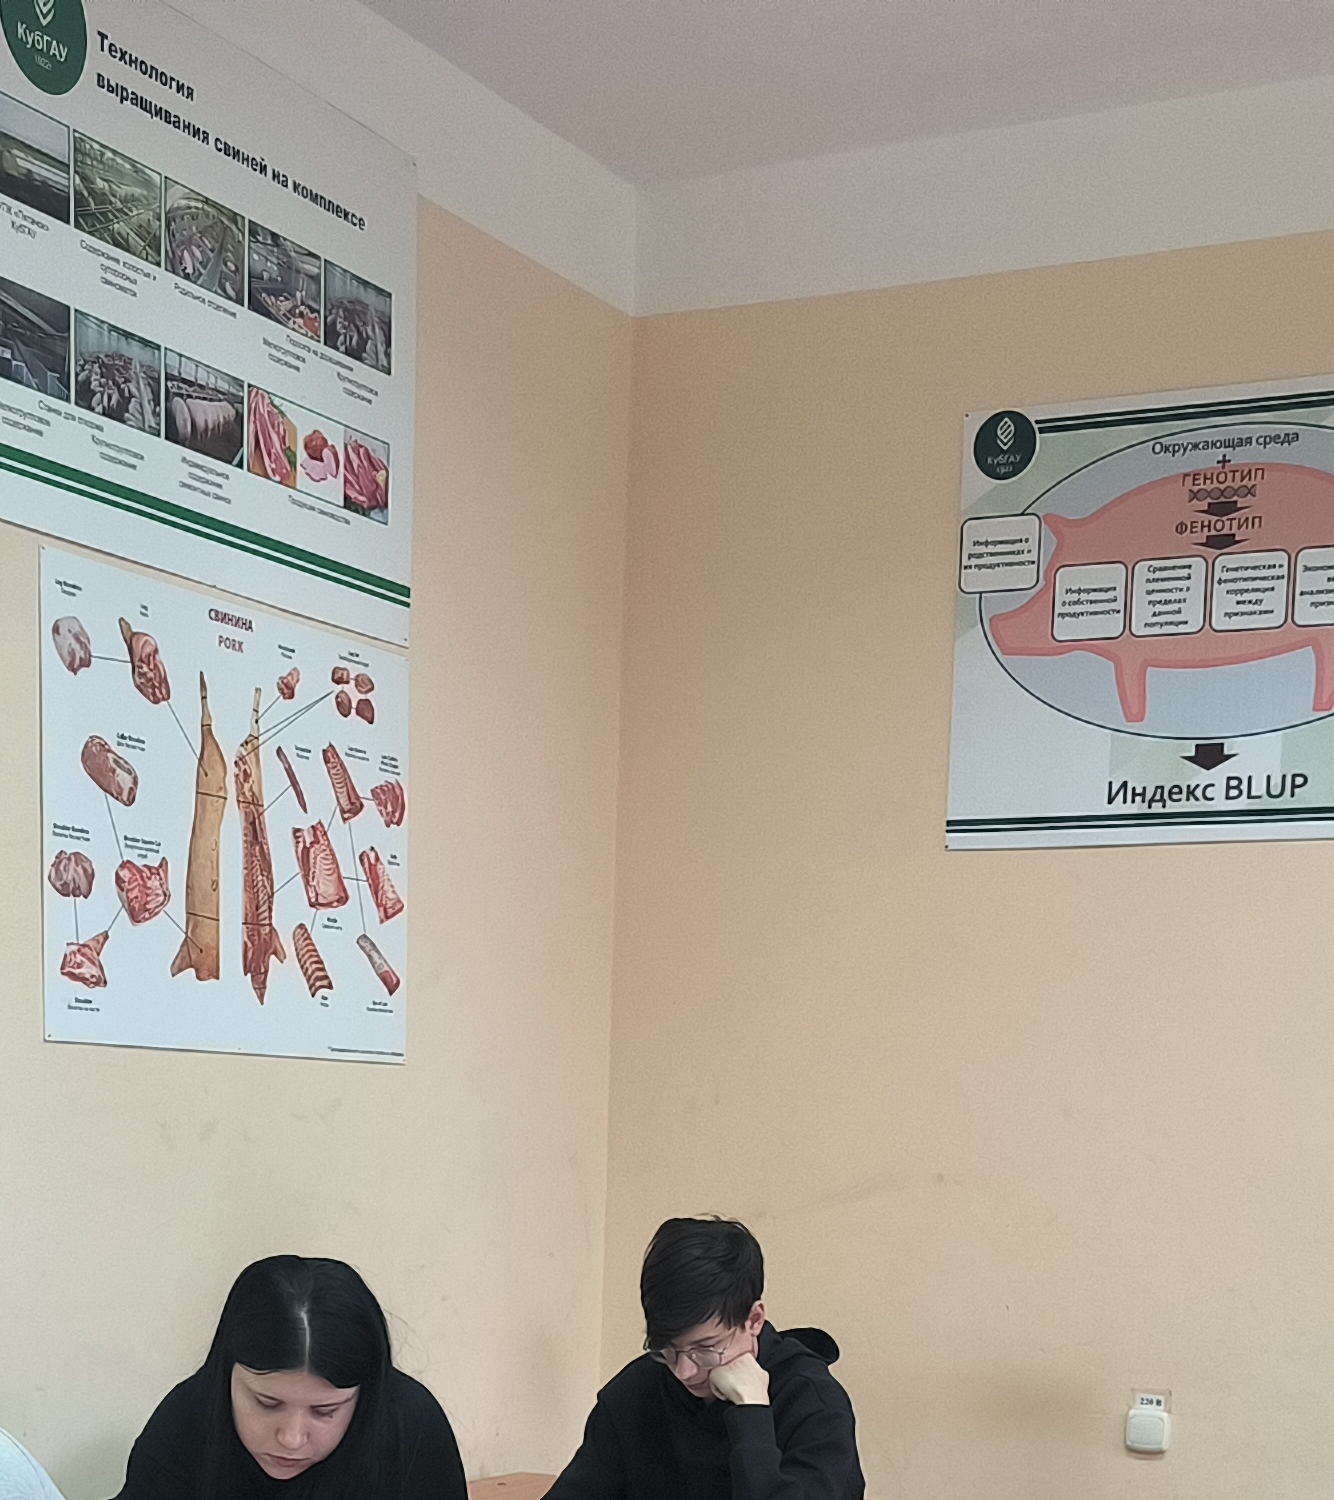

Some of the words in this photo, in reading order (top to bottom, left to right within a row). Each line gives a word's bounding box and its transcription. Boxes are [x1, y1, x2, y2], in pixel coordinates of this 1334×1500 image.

[17, 20, 68, 62] КубГАУ
[97, 30, 195, 102] Технология
[97, 72, 210, 146] выращивания
[214, 137, 268, 178] свиней
[271, 168, 289, 188] на
[292, 179, 366, 232] комплексе
[1151, 435, 1252, 457] Окружающая
[1256, 431, 1300, 449] среда
[1181, 467, 1265, 487] ГЕНОТИП
[1175, 515, 1263, 536] ФЕНОТИП
[208, 608, 254, 633] СВИНИНА
[218, 635, 245, 654] PORK
[1107, 780, 1216, 810] Индекс
[1225, 773, 1309, 800] BLUP
